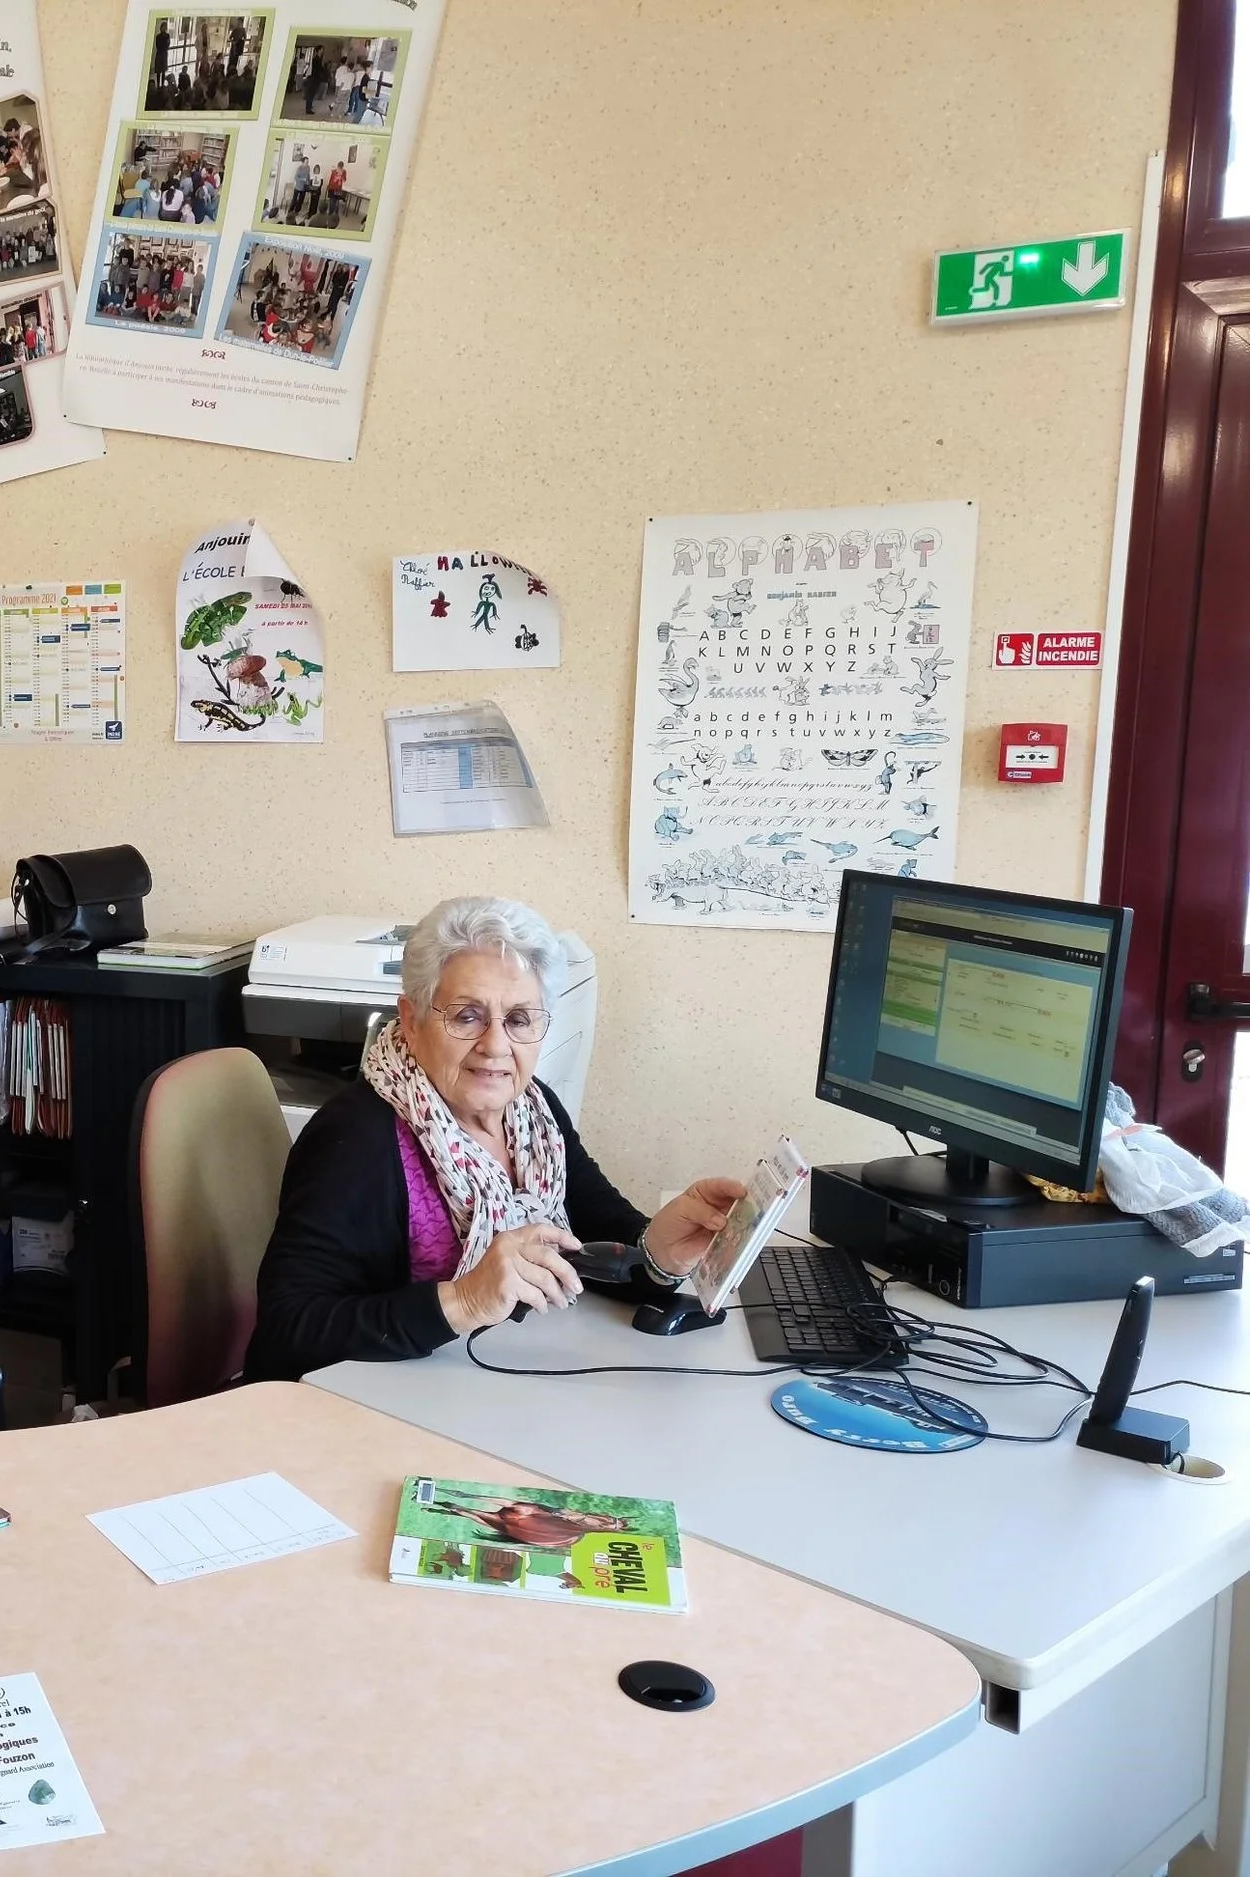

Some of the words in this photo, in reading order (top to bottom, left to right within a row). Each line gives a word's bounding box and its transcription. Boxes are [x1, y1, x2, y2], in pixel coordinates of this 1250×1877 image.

[672, 540, 935, 578] ALPHABET
[183, 562, 236, 582] L'ÉCOLE
[2, 596, 40, 606] Programme
[42, 593, 57, 604] 2021
[699, 630, 709, 640] A
[718, 629, 726, 640] B
[739, 629, 747, 640] C
[761, 628, 770, 639] D
[784, 628, 791, 639] E
[805, 627, 811, 638] F
[825, 627, 835, 638] G
[849, 626, 859, 637] H
[890, 625, 895, 636] J
[1044, 637, 1095, 648] ALARME
[698, 647, 706, 657] K
[718, 646, 724, 657] L
[736, 646, 749, 656] M
[761, 645, 770, 656] N
[782, 645, 793, 656] O
[805, 644, 813, 655] P
[824, 644, 835, 656] Q
[847, 643, 855, 654] R
[868, 643, 875, 654] S
[887, 642, 895, 653] T
[1038, 651, 1098, 661] INCENDIE
[733, 662, 742, 673] U
[755, 662, 765, 672] V
[776, 662, 791, 672] W
[803, 661, 812, 672] X
[826, 661, 835, 671] Y
[847, 660, 855, 671] Z
[928, 1124, 942, 1136] AOC
[641, 1542, 652, 1552] le
[607, 1541, 649, 1594] CHEVAL
[4, 1709, 12, 1718] à
[13, 1706, 32, 1717] 15h
[19, 1761, 55, 1774] Association
